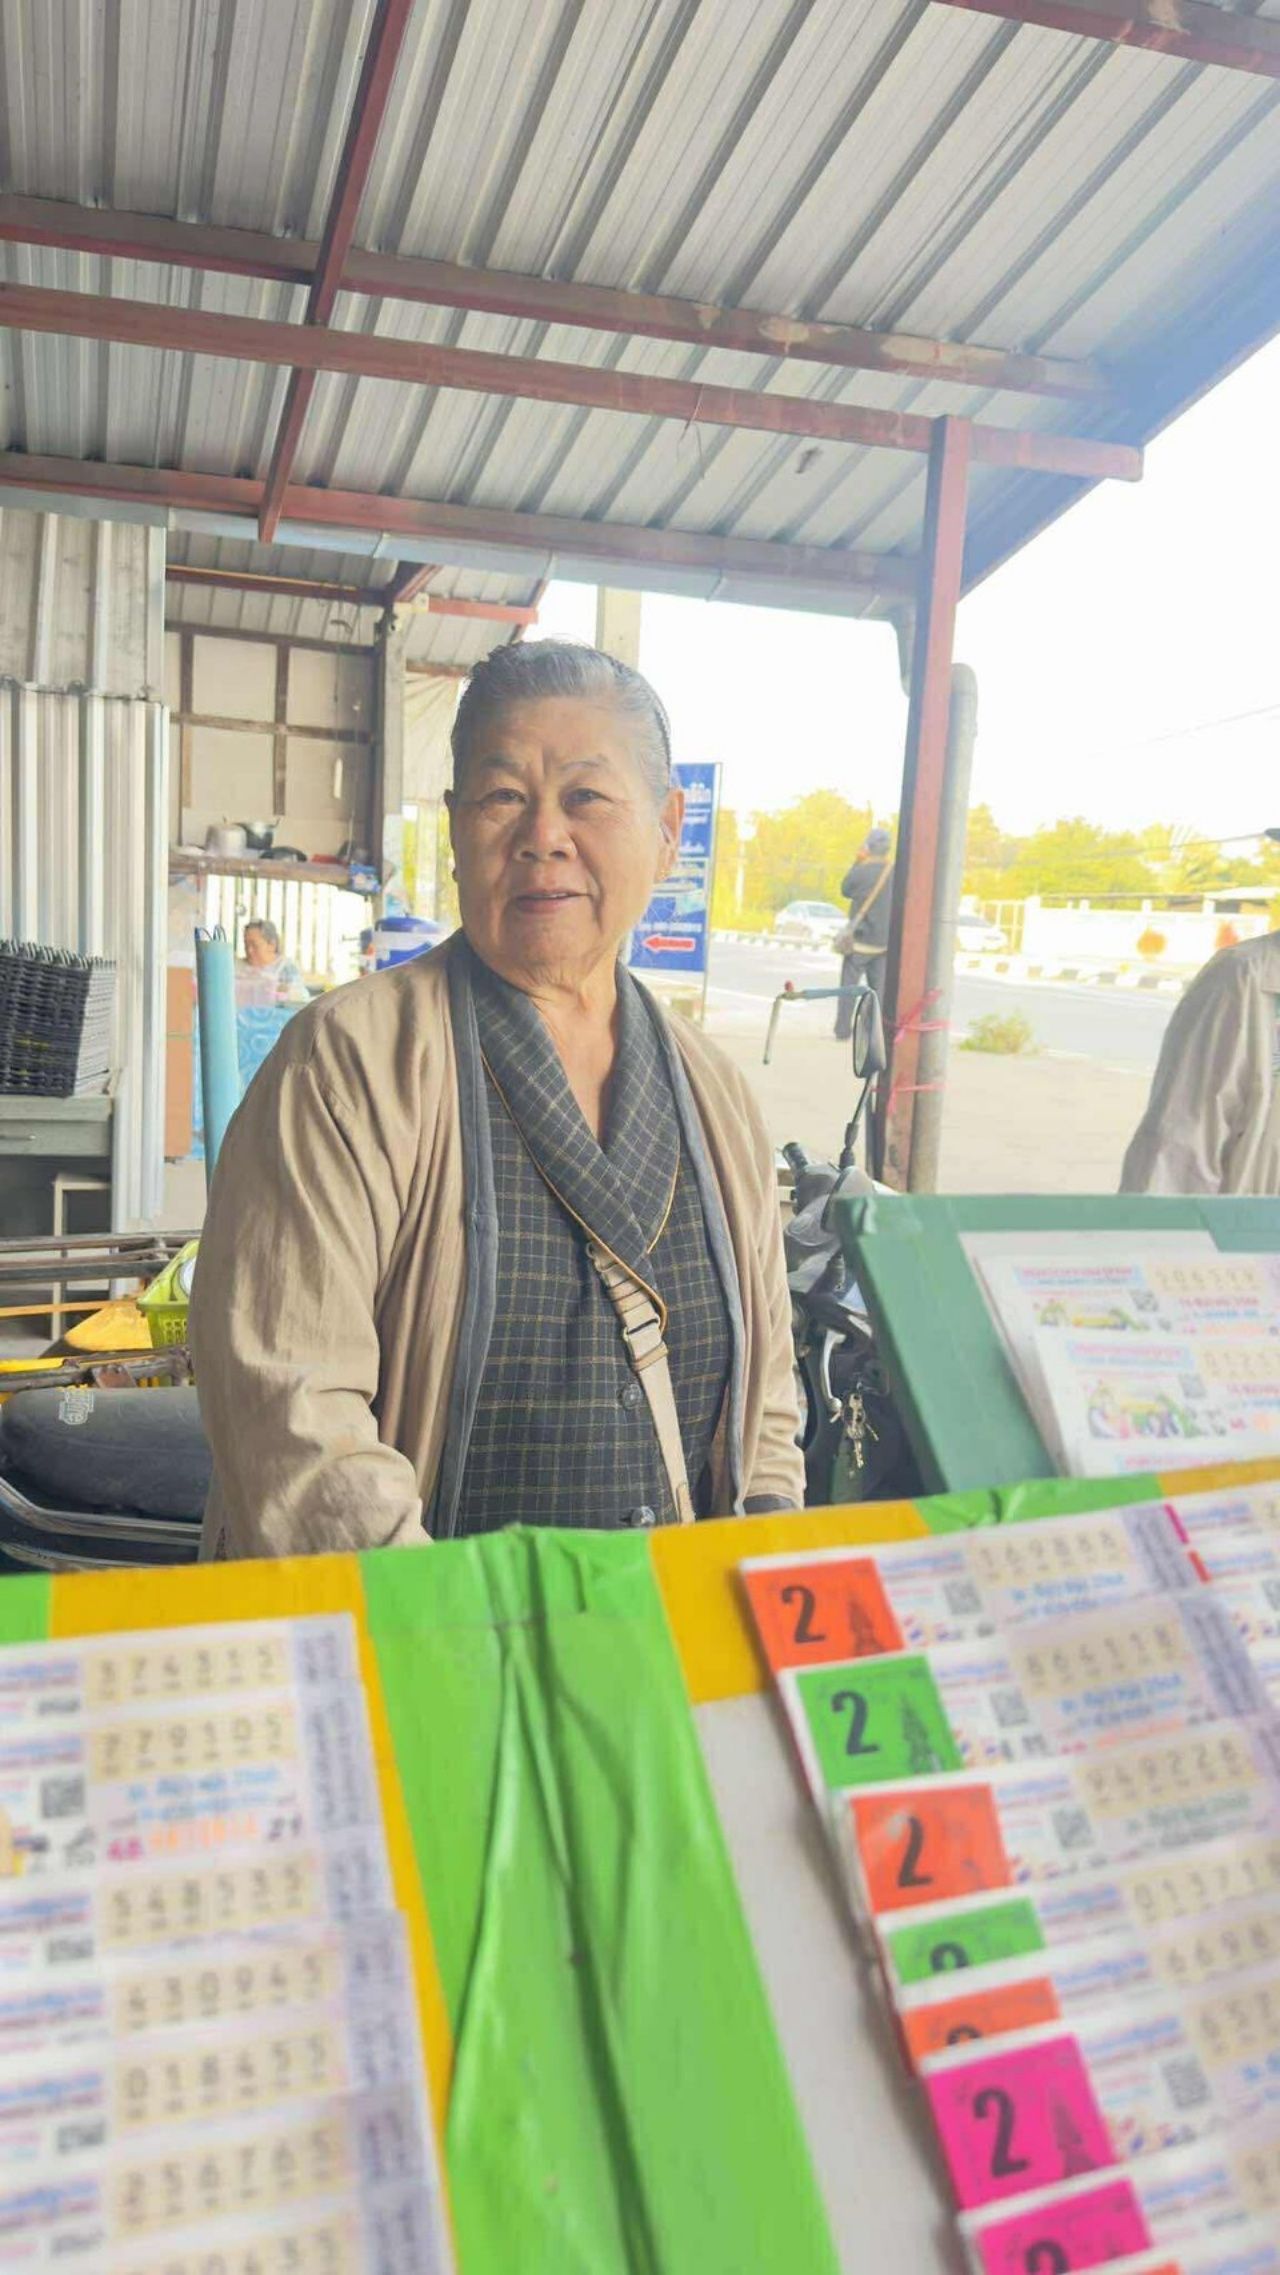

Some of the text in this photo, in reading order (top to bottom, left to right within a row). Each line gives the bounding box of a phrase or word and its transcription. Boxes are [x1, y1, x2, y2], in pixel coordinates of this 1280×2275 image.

[781, 1585, 826, 1643] 2
[831, 1689, 880, 1756] 2
[973, 2087, 1029, 2178] 2
